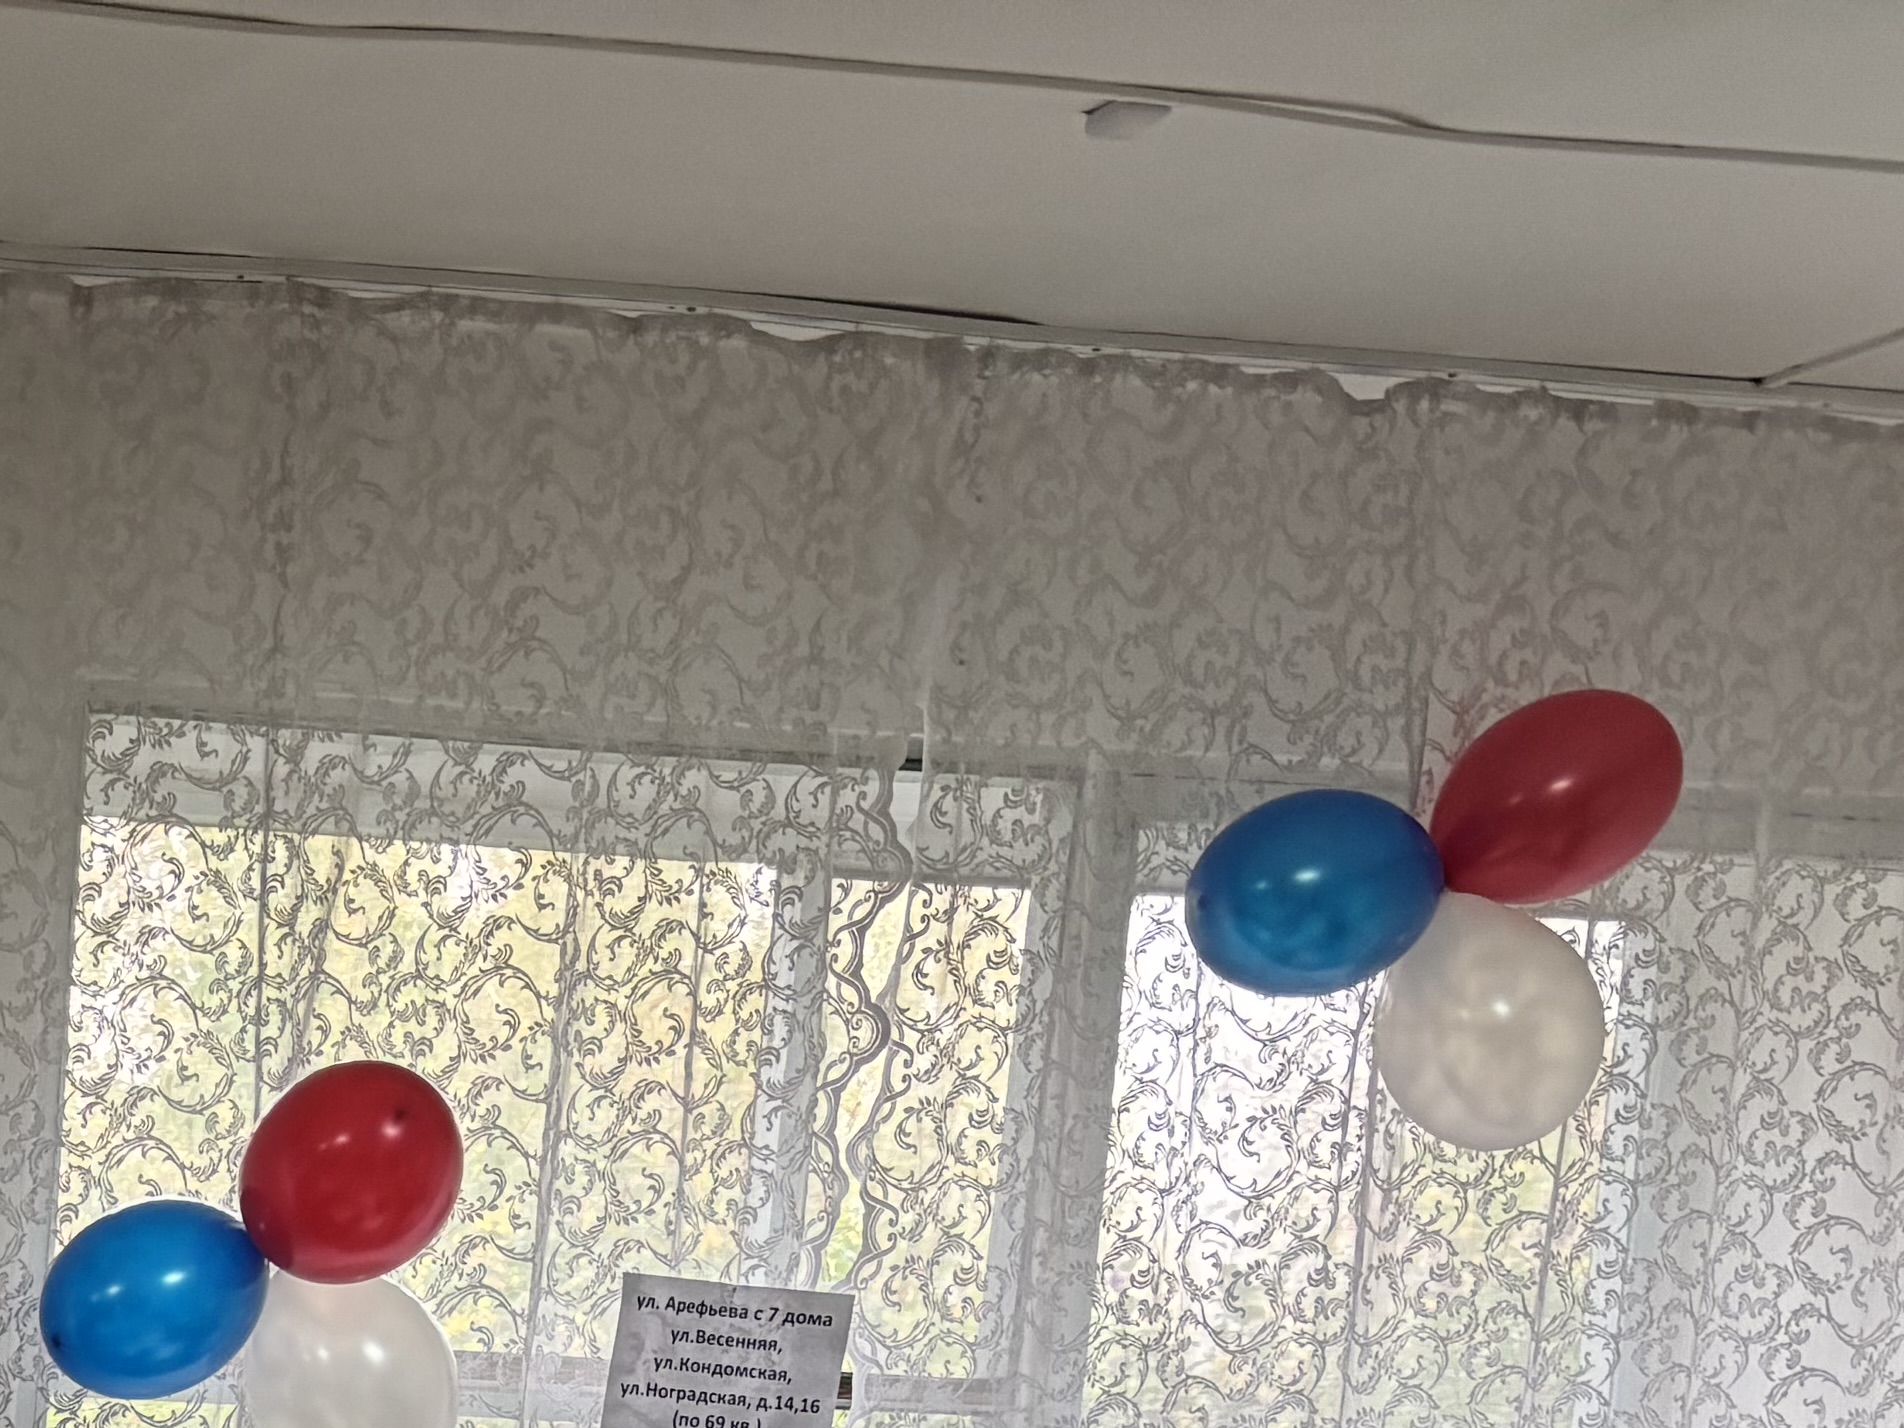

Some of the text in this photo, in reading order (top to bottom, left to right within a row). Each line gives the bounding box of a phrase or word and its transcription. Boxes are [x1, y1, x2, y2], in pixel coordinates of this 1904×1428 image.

[637, 1295, 833, 1327] ул. Арефьева с 7 дома
[671, 1329, 782, 1354] ул.Весенняя,
[654, 1357, 792, 1385] ул.Кондомская,
[621, 1382, 820, 1414] ул.Ноградская, д.14,16
[673, 1411, 700, 1428] (по
